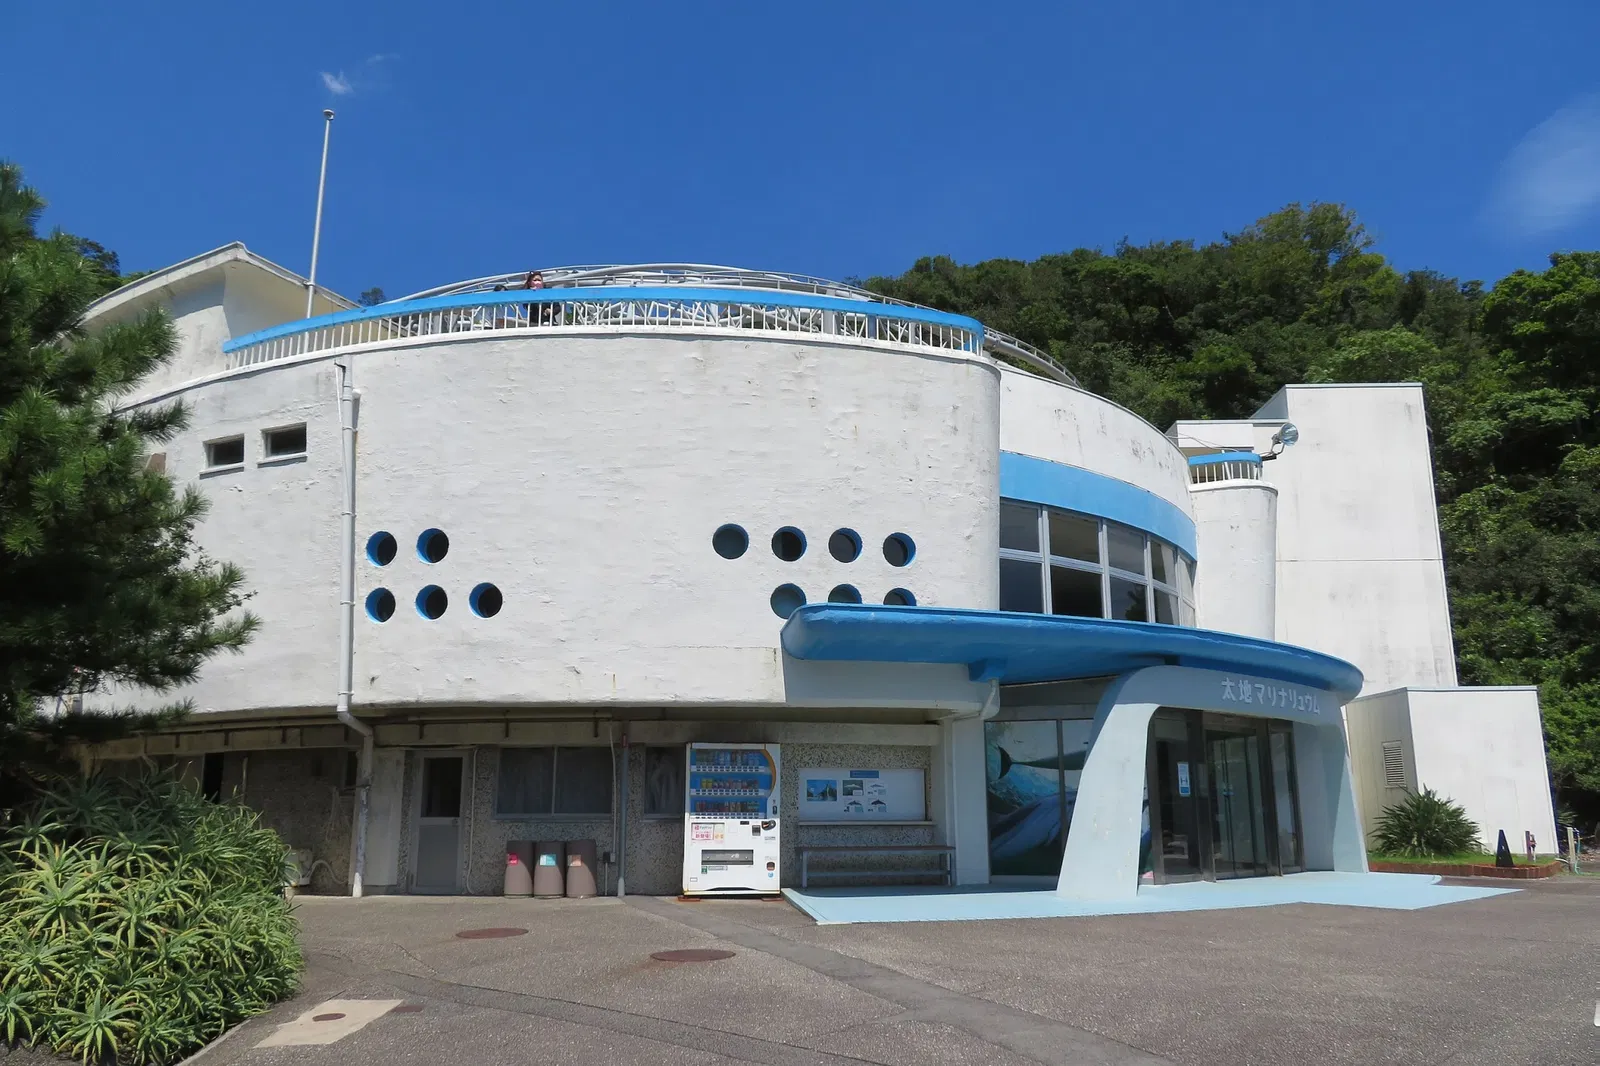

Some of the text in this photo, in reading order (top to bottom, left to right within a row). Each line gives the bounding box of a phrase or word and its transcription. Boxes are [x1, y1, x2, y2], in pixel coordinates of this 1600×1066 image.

[1221, 677, 1320, 715] 太地マリナリュウム
